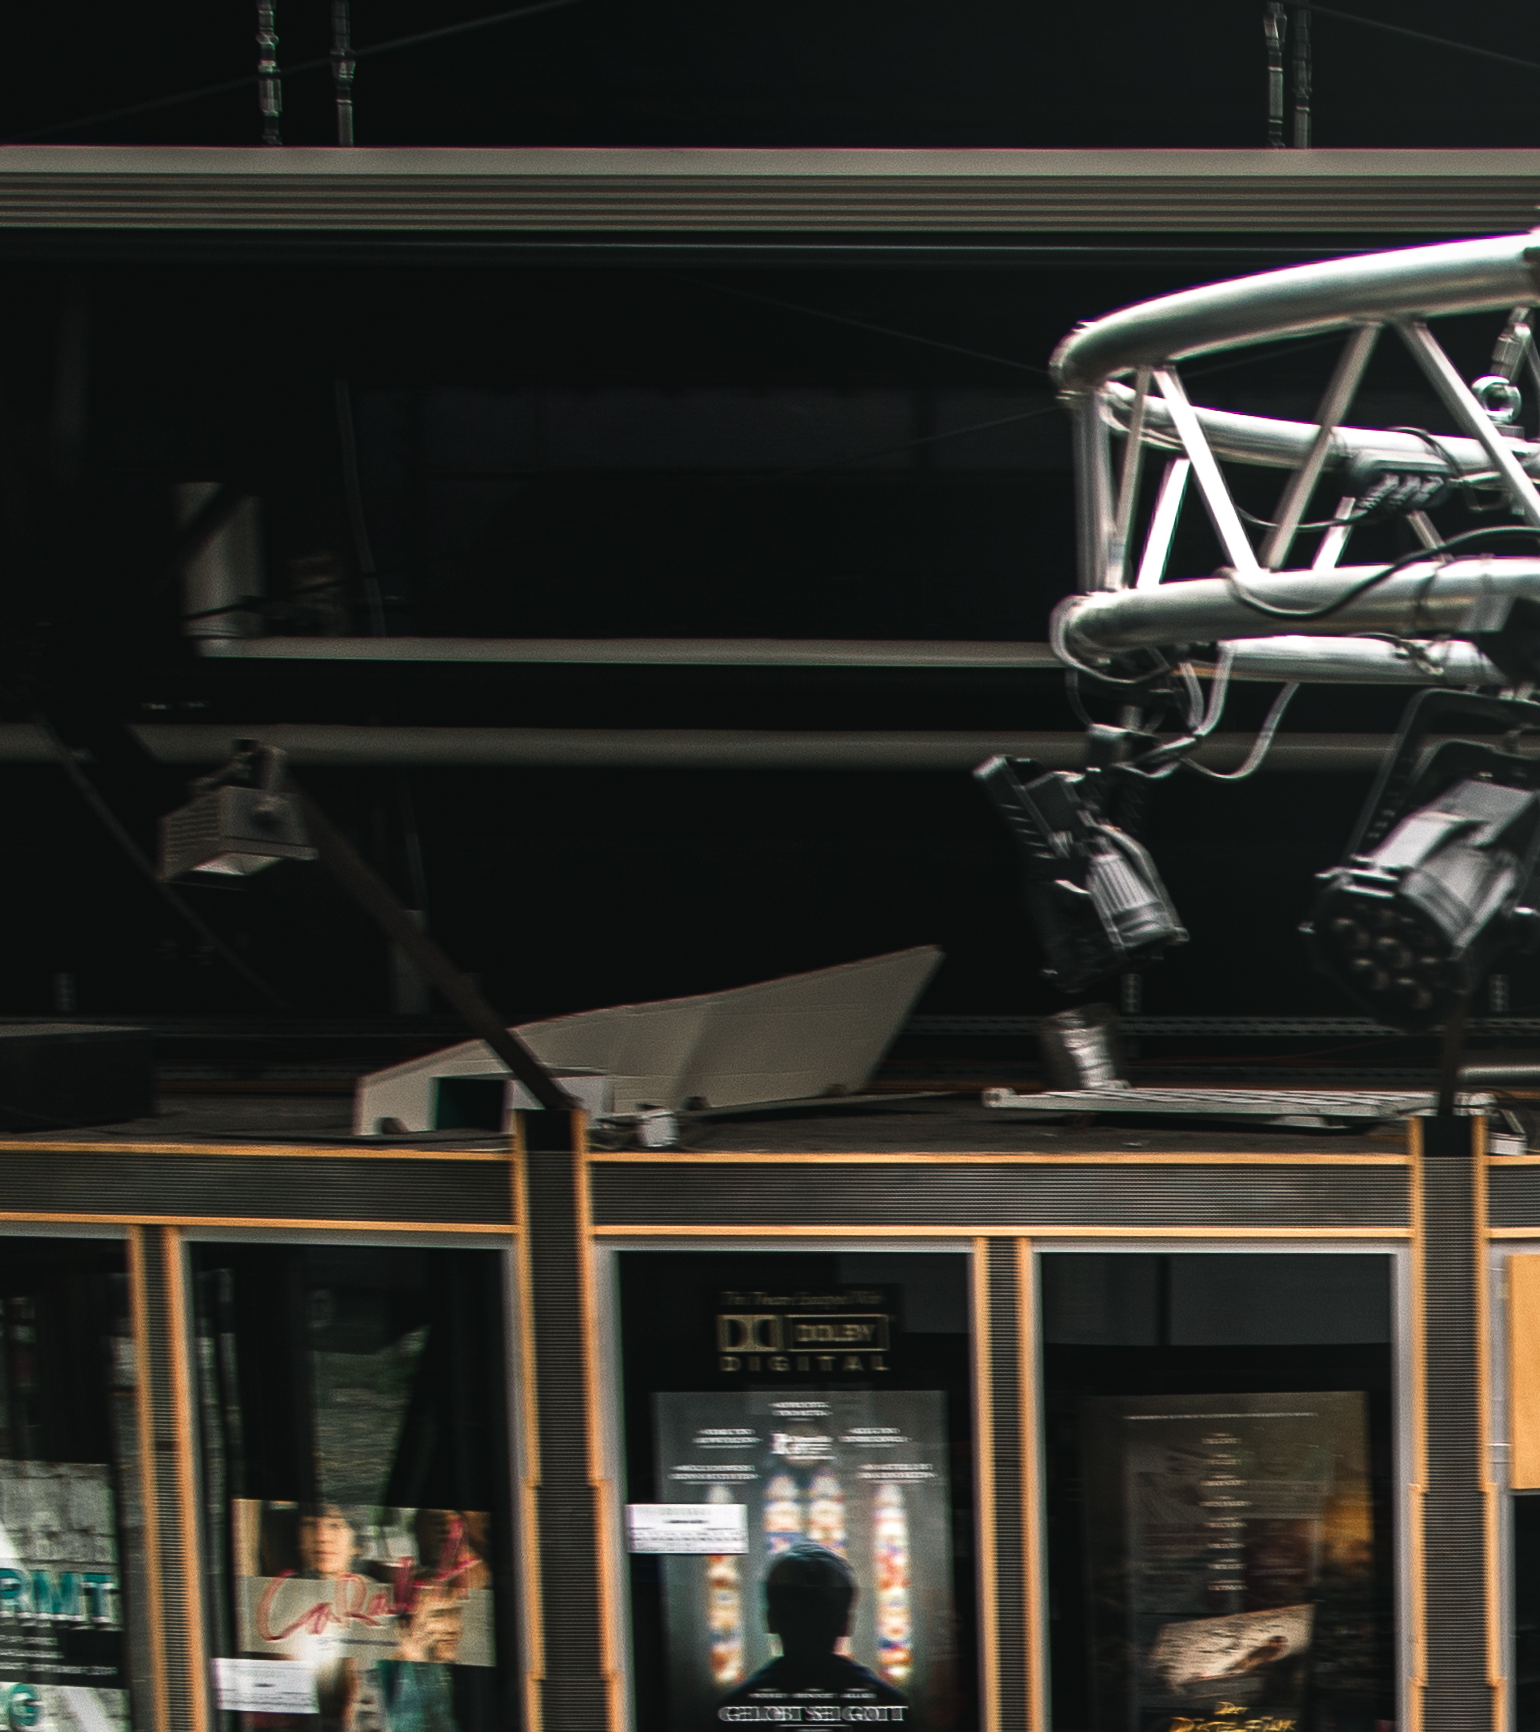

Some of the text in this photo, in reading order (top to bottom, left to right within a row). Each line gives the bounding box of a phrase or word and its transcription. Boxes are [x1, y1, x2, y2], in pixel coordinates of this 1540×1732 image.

[796, 1324, 875, 1342] DOLBY
[720, 1355, 892, 1372] DIGITAL
[717, 1705, 910, 1722] GELOBT SEI GOTT
